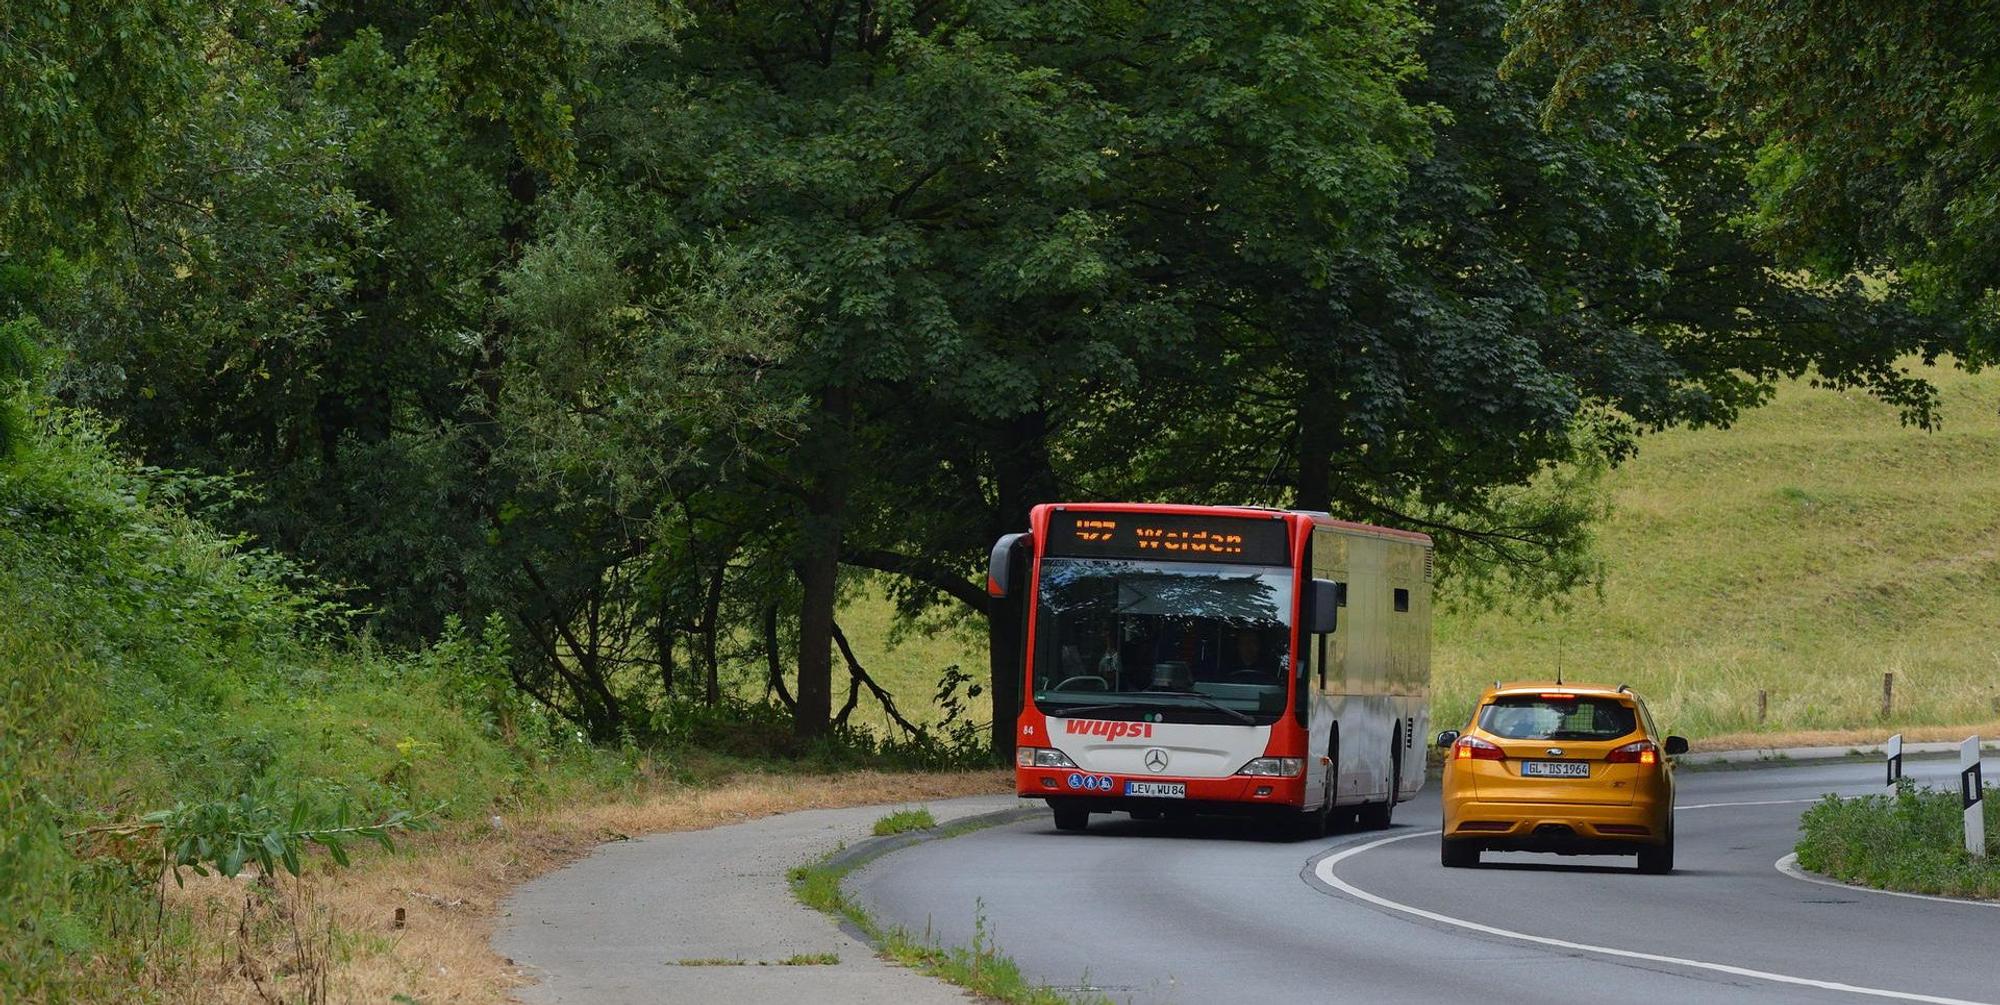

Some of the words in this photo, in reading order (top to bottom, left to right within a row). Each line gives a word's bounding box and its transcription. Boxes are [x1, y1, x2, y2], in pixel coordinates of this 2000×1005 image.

[1023, 725, 1034, 735] 84
[1066, 715, 1153, 741] wupsi
[1529, 763, 1541, 774] GL
[1131, 783, 1151, 794] LEV
